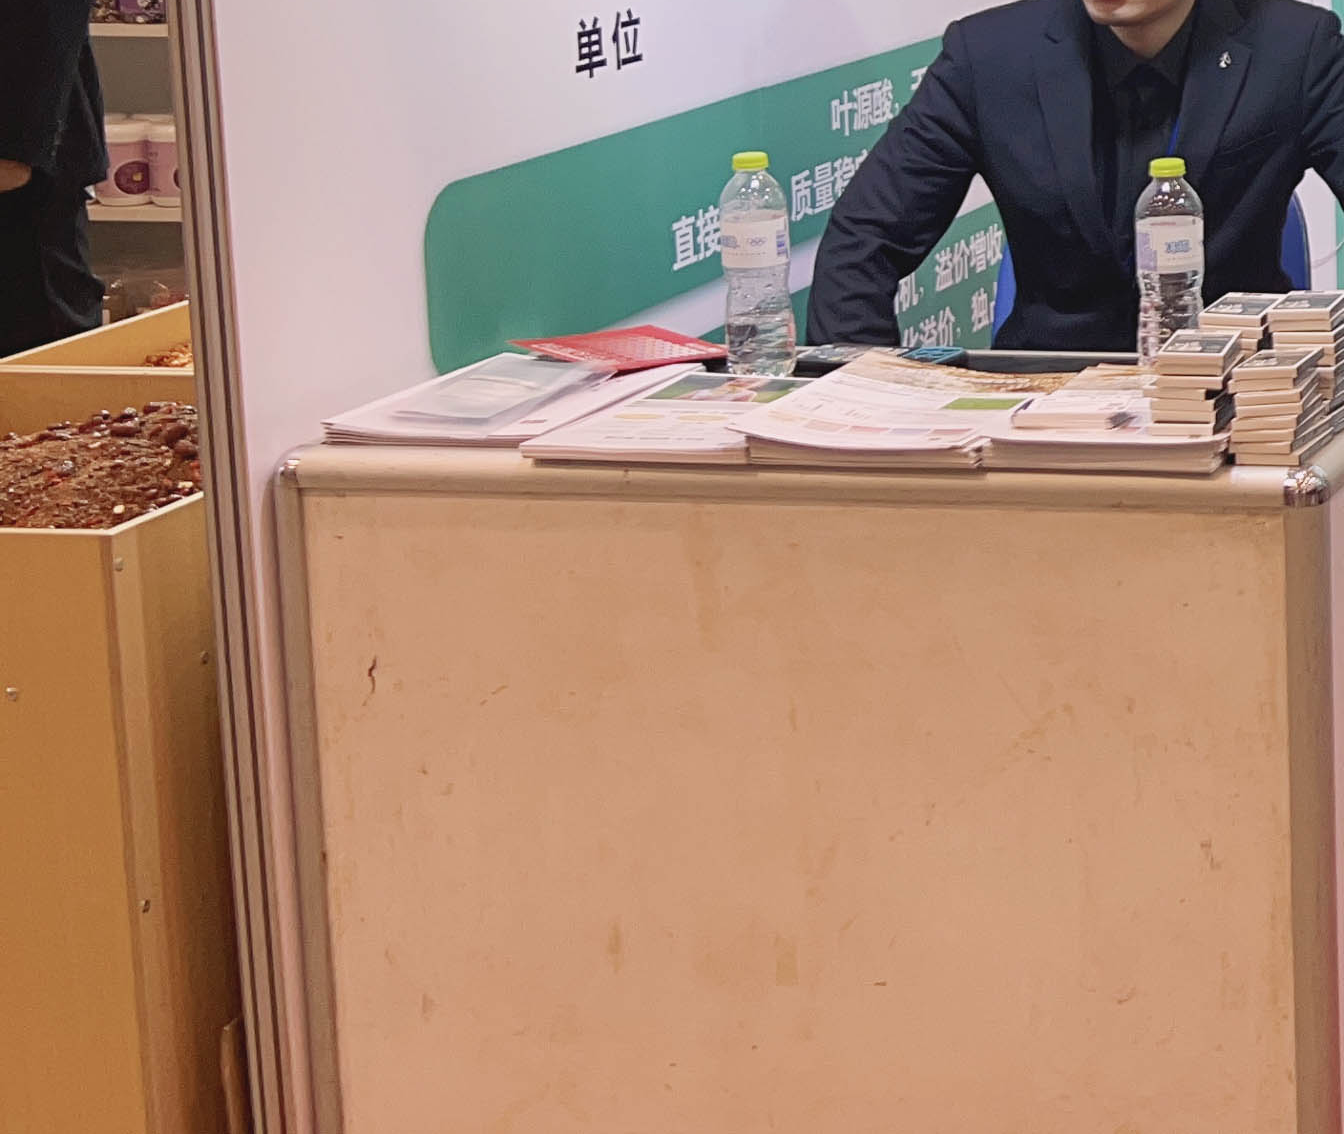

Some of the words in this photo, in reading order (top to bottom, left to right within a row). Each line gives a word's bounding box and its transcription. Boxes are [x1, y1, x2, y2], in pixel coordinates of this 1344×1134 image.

[576, 9, 643, 78] 单位
[894, 223, 1003, 315] 机，溢价增收
